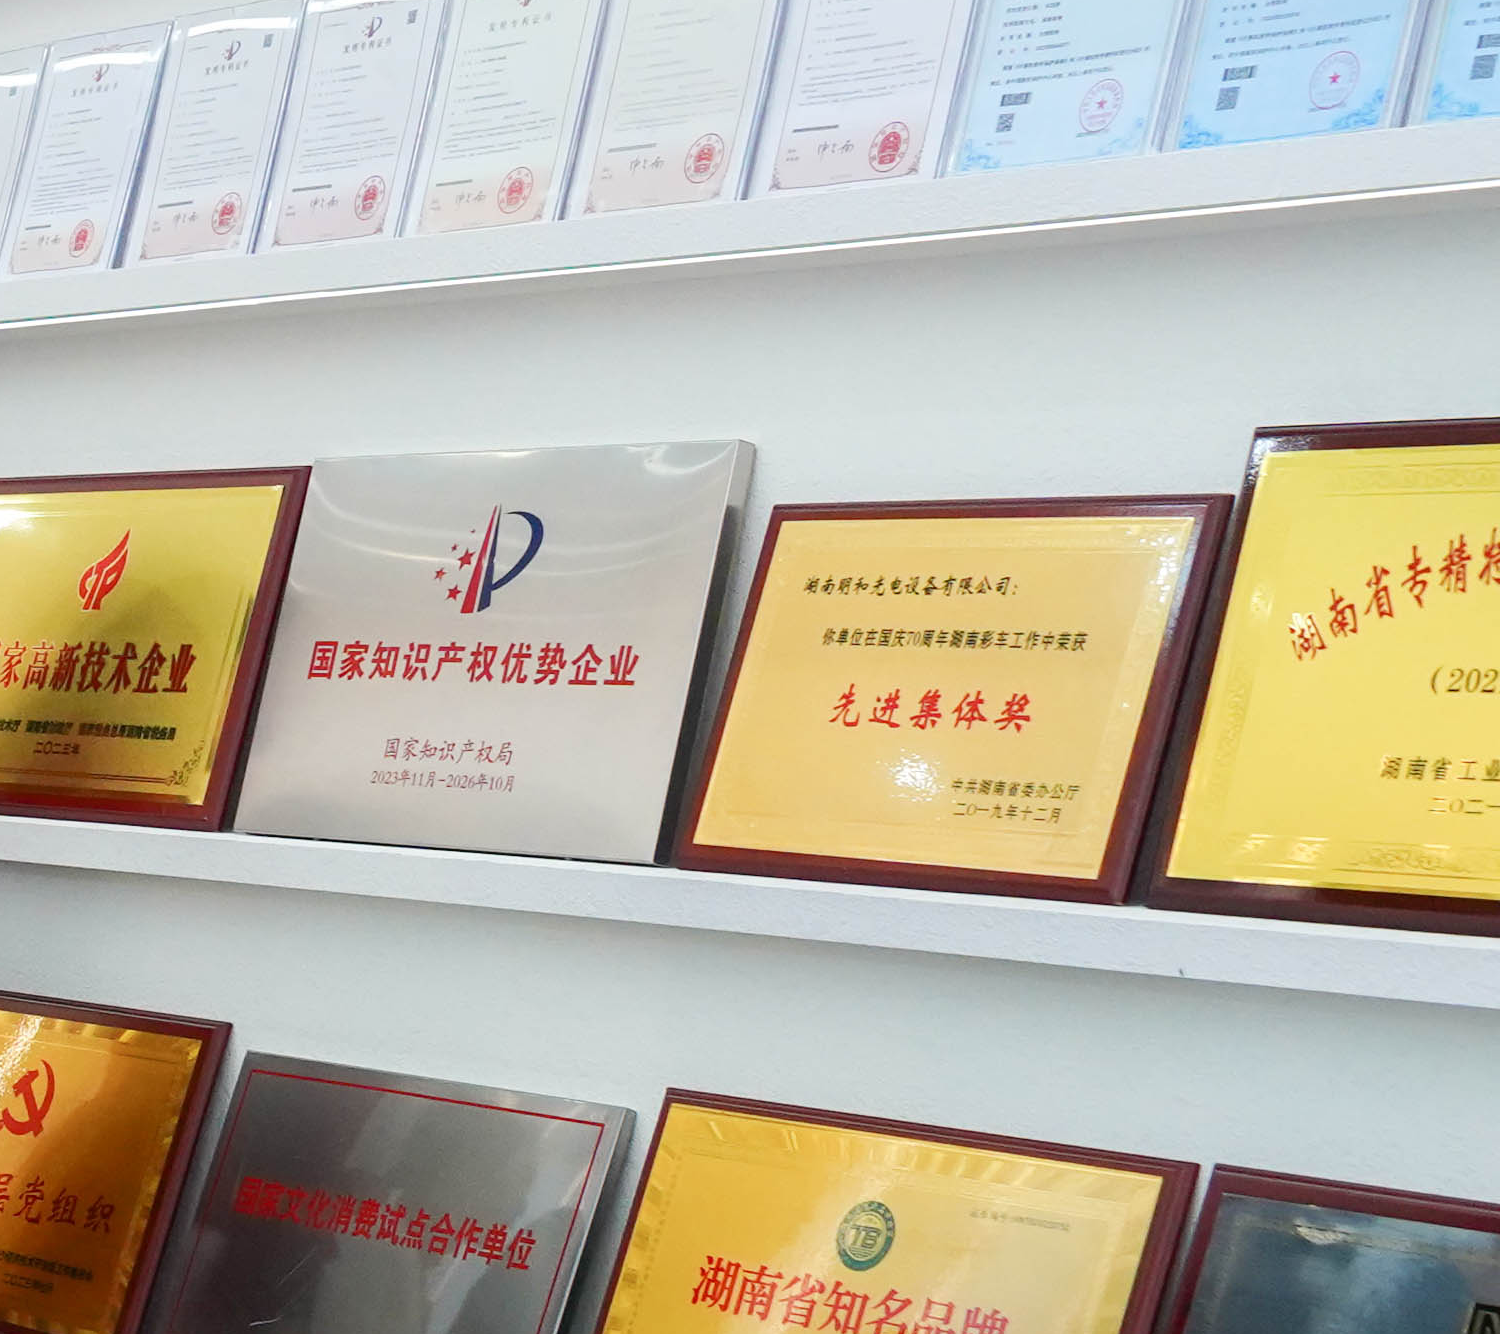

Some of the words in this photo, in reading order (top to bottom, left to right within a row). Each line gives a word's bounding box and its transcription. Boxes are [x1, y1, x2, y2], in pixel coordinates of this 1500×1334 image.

[821, 627, 1089, 653] 你单位在国庆70周年湖南彩车工作中荣获
[306, 639, 640, 687] 国家知识产权优势企业
[1429, 666, 1500, 695] (202
[827, 682, 1034, 734] 先进集体奖
[382, 737, 513, 767] 国家知识产权局
[951, 776, 1082, 802] 中共湖南省委办公厅
[233, 1174, 539, 1273] 国家文化消费试点合作单位
